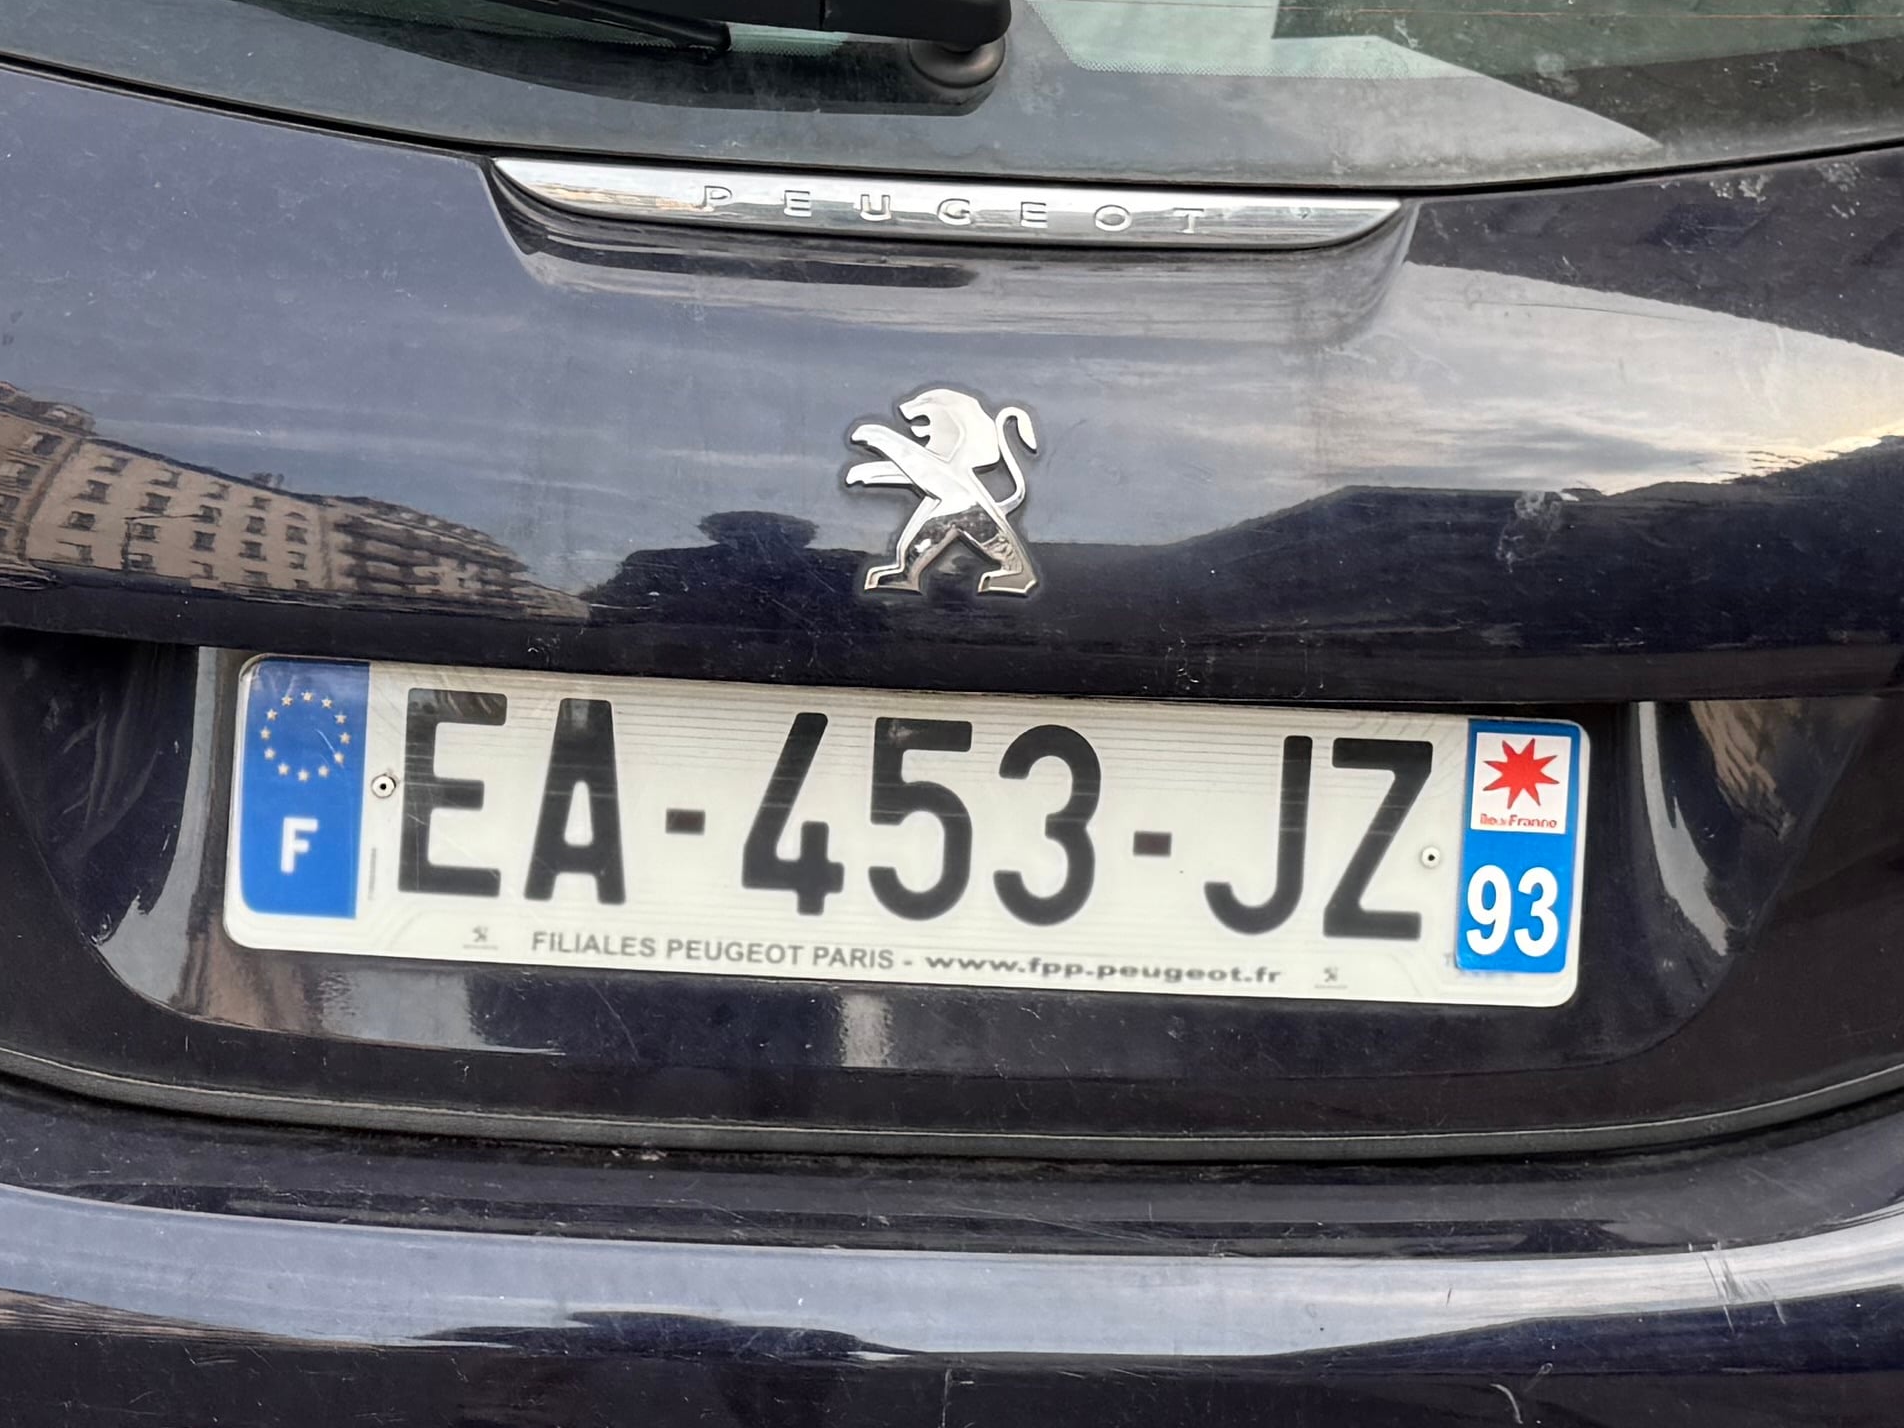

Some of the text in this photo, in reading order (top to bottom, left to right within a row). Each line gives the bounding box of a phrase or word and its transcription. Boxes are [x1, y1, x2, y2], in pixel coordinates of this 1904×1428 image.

[698, 185, 1206, 234] PEUGEOT
[397, 686, 1435, 941] EA-453-JZ
[280, 816, 319, 874] F
[1465, 863, 1559, 958] 93
[531, 929, 656, 958] FILIALES
[666, 938, 804, 966] PEUGEOT
[811, 945, 895, 970] PARIS
[924, 954, 1283, 985] www.fpp.peugeot.fr
